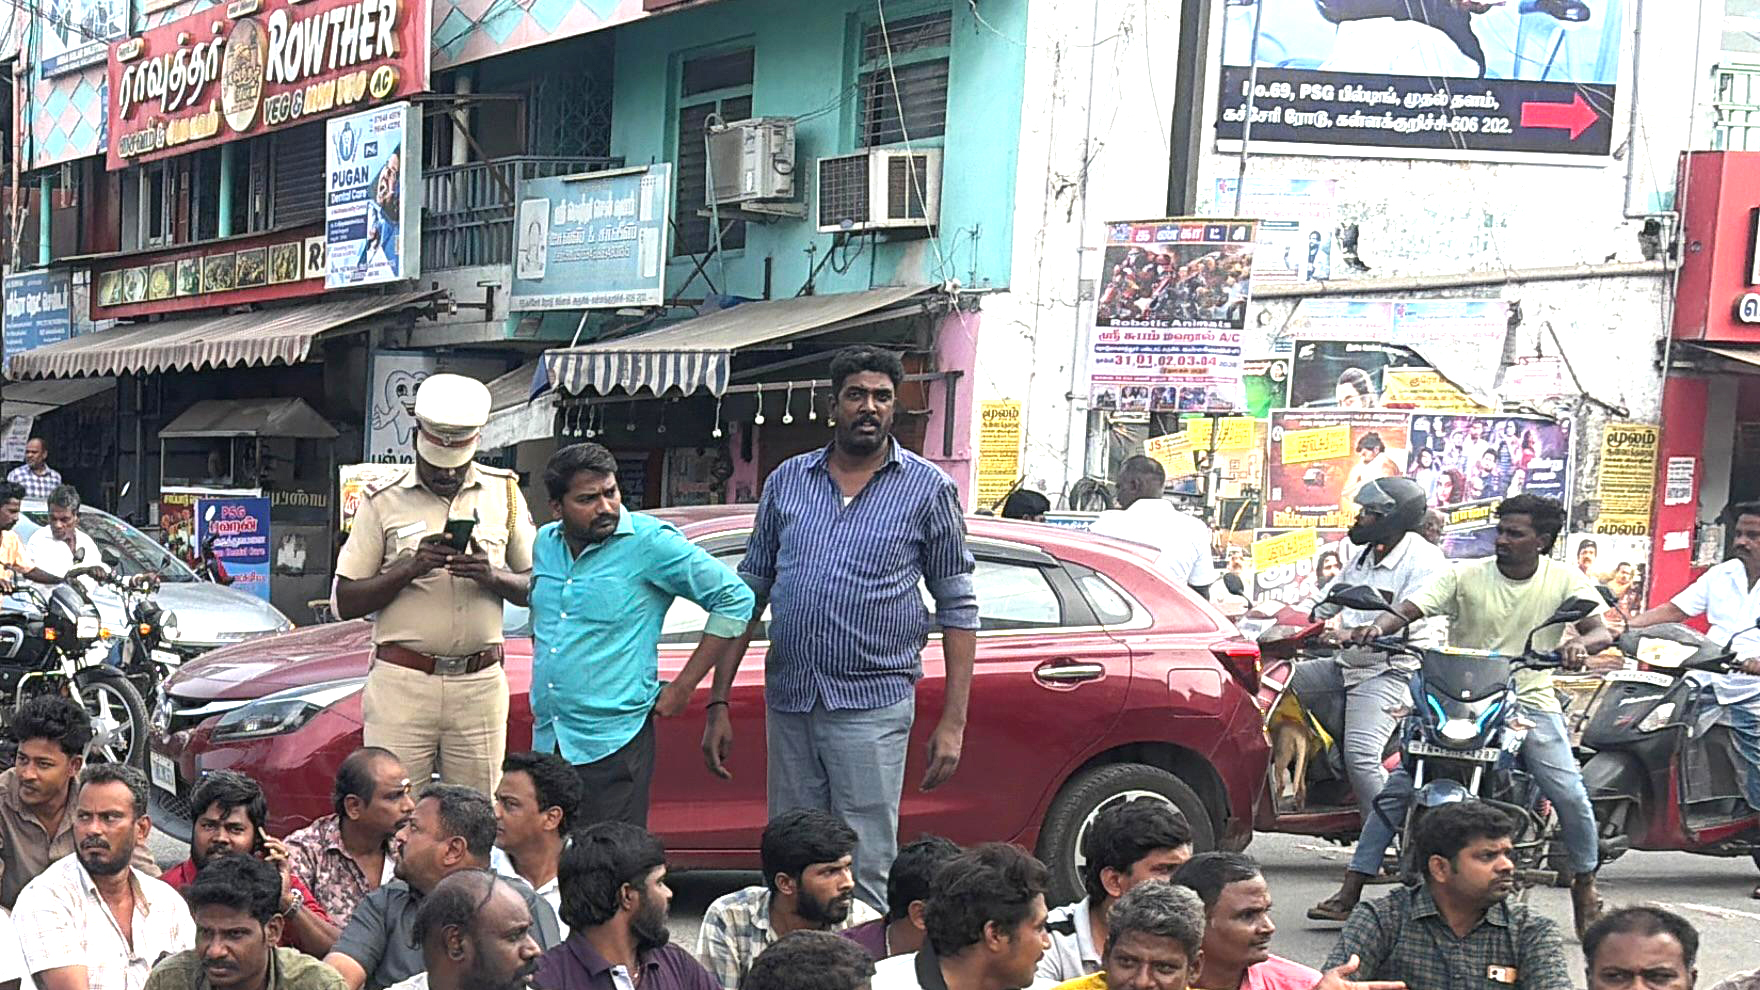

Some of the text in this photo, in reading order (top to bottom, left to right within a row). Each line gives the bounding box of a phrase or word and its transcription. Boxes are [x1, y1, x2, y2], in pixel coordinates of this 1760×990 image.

[266, 0, 397, 84] ROWTHER
[119, 21, 225, 119] ராவுத்தர்
[263, 91, 290, 126] VEG
[290, 88, 303, 119] &
[373, 69, 392, 93] AC
[1299, 86, 1335, 101] PSG
[1481, 117, 1513, 134] 202.
[332, 165, 369, 190] PUGAN
[330, 190, 351, 205] Dental
[1110, 318, 1232, 330] Robotic Animals
[1219, 332, 1240, 343] A/C
[982, 406, 1020, 421] மூலம்
[1607, 430, 1655, 447] மூலம்
[221, 505, 246, 519] PSG
